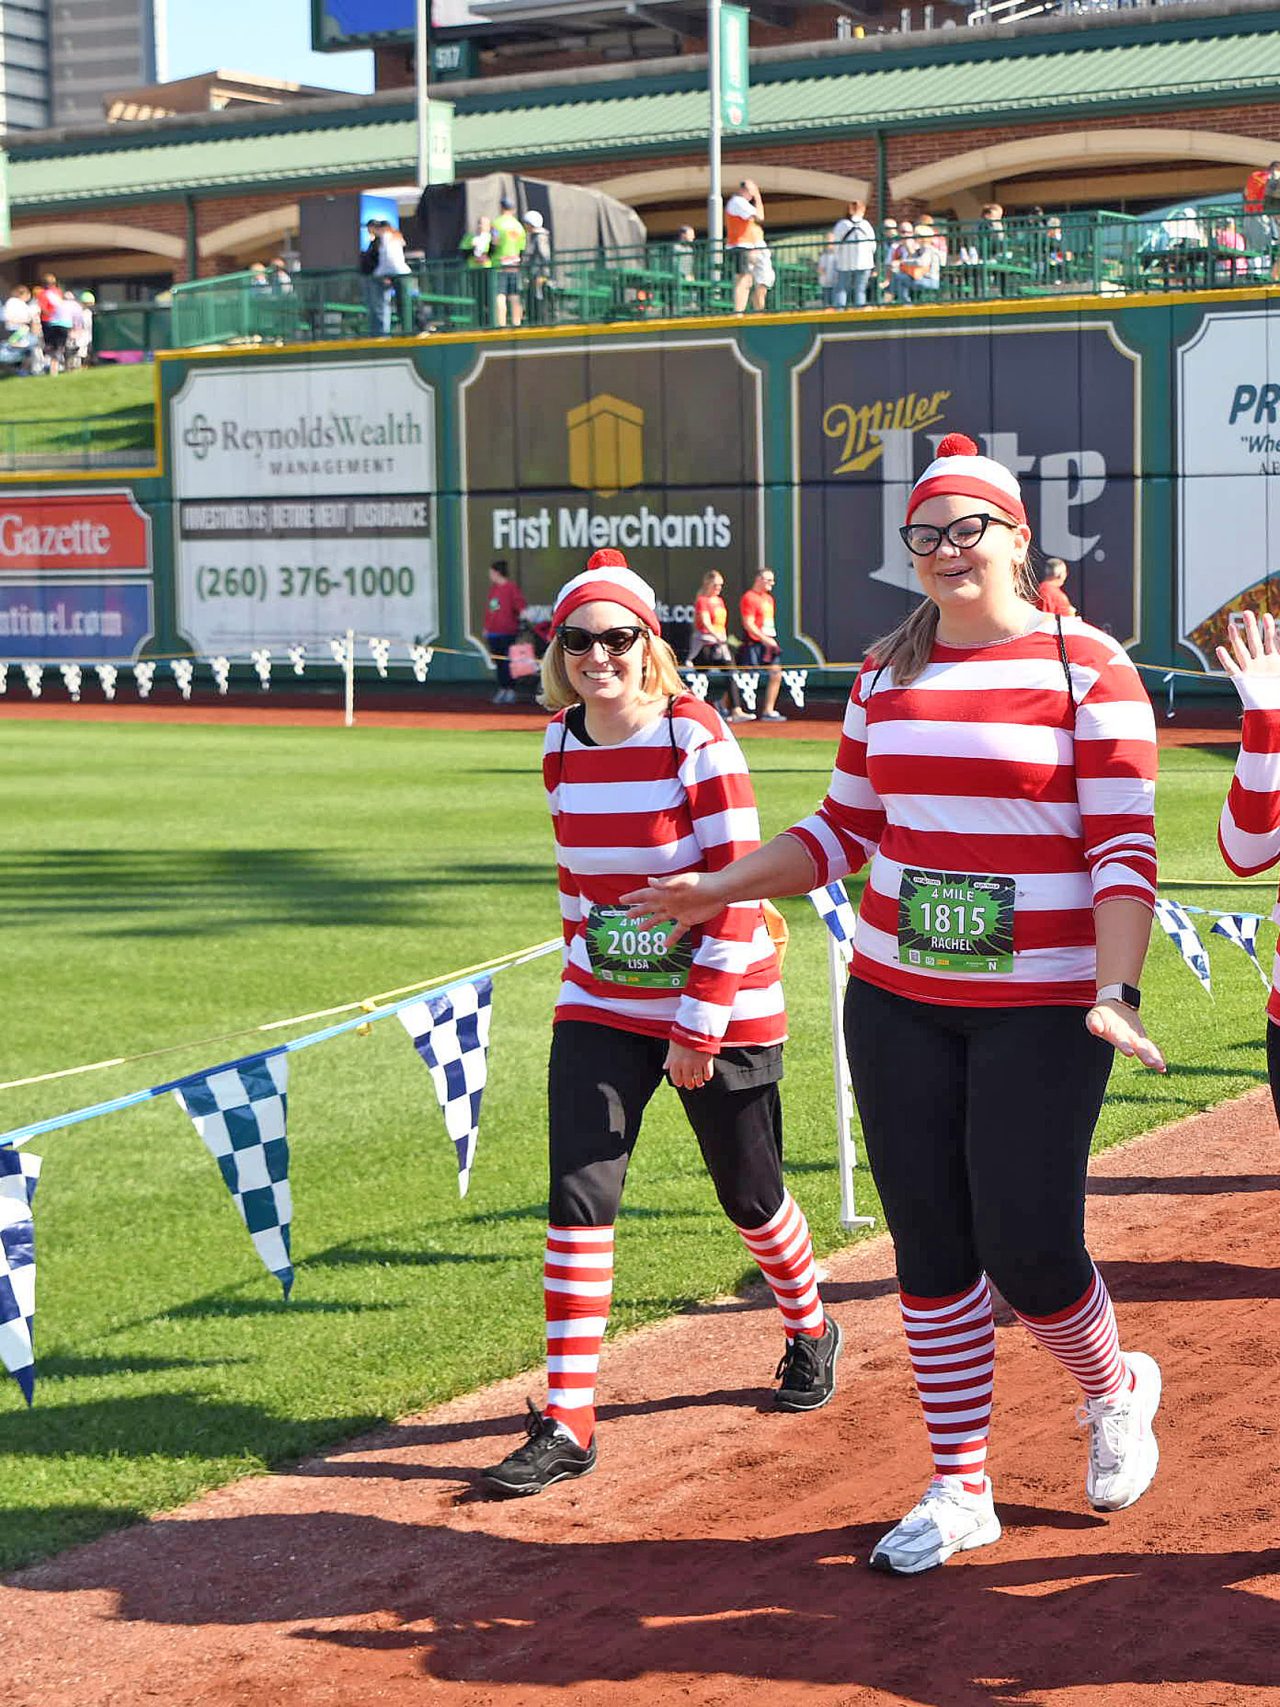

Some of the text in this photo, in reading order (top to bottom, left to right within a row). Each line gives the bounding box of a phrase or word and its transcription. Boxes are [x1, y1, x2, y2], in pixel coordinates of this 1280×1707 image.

[221, 413, 422, 459] ReynoldsWealth
[823, 390, 952, 474] Miller
[269, 458, 395, 476] MANAGEMENT
[1259, 463, 1268, 475] A
[0, 514, 111, 556] Gazette
[492, 505, 732, 549] First Merchants
[196, 565, 415, 602] (260) 376-1000
[931, 888, 976, 902] 4 MILE
[619, 918, 627, 927] 4
[920, 902, 986, 936] 1815
[607, 930, 668, 956] 2088
[931, 936, 973, 951] RACHEL
[628, 959, 650, 970] LISA
[988, 961, 998, 971] N
